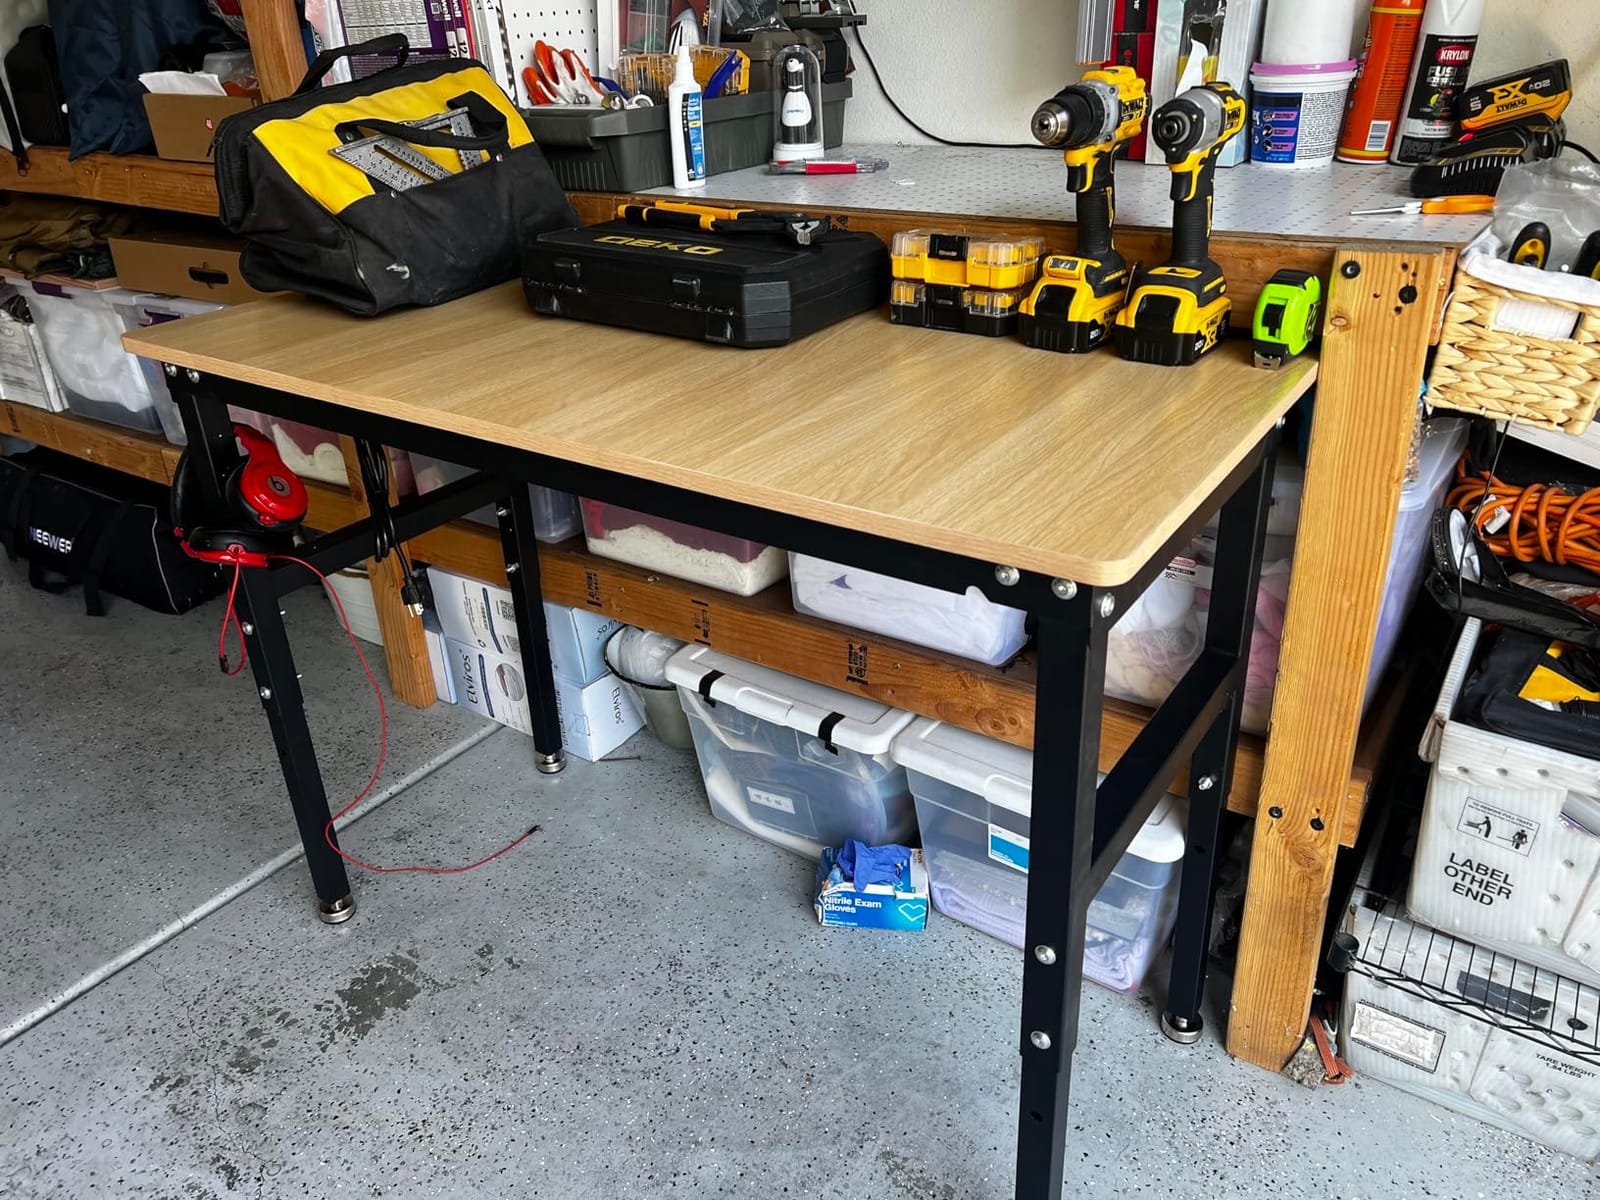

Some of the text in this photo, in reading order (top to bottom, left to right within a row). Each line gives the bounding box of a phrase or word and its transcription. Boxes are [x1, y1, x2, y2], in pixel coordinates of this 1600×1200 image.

[1440, 49, 1471, 60] KRYLON
[593, 235, 723, 255] DEKO
[29, 526, 73, 554] NEEWER
[461, 653, 478, 704] Elviros
[611, 686, 623, 725] Elviros
[1449, 852, 1514, 887] LABEL
[1444, 865, 1512, 900] OTHER
[1452, 882, 1494, 906] END
[823, 896, 882, 909] Nitrile Exam
[823, 903, 857, 914] Gloves
[1536, 1053, 1597, 1078] TARE WEIGHT
